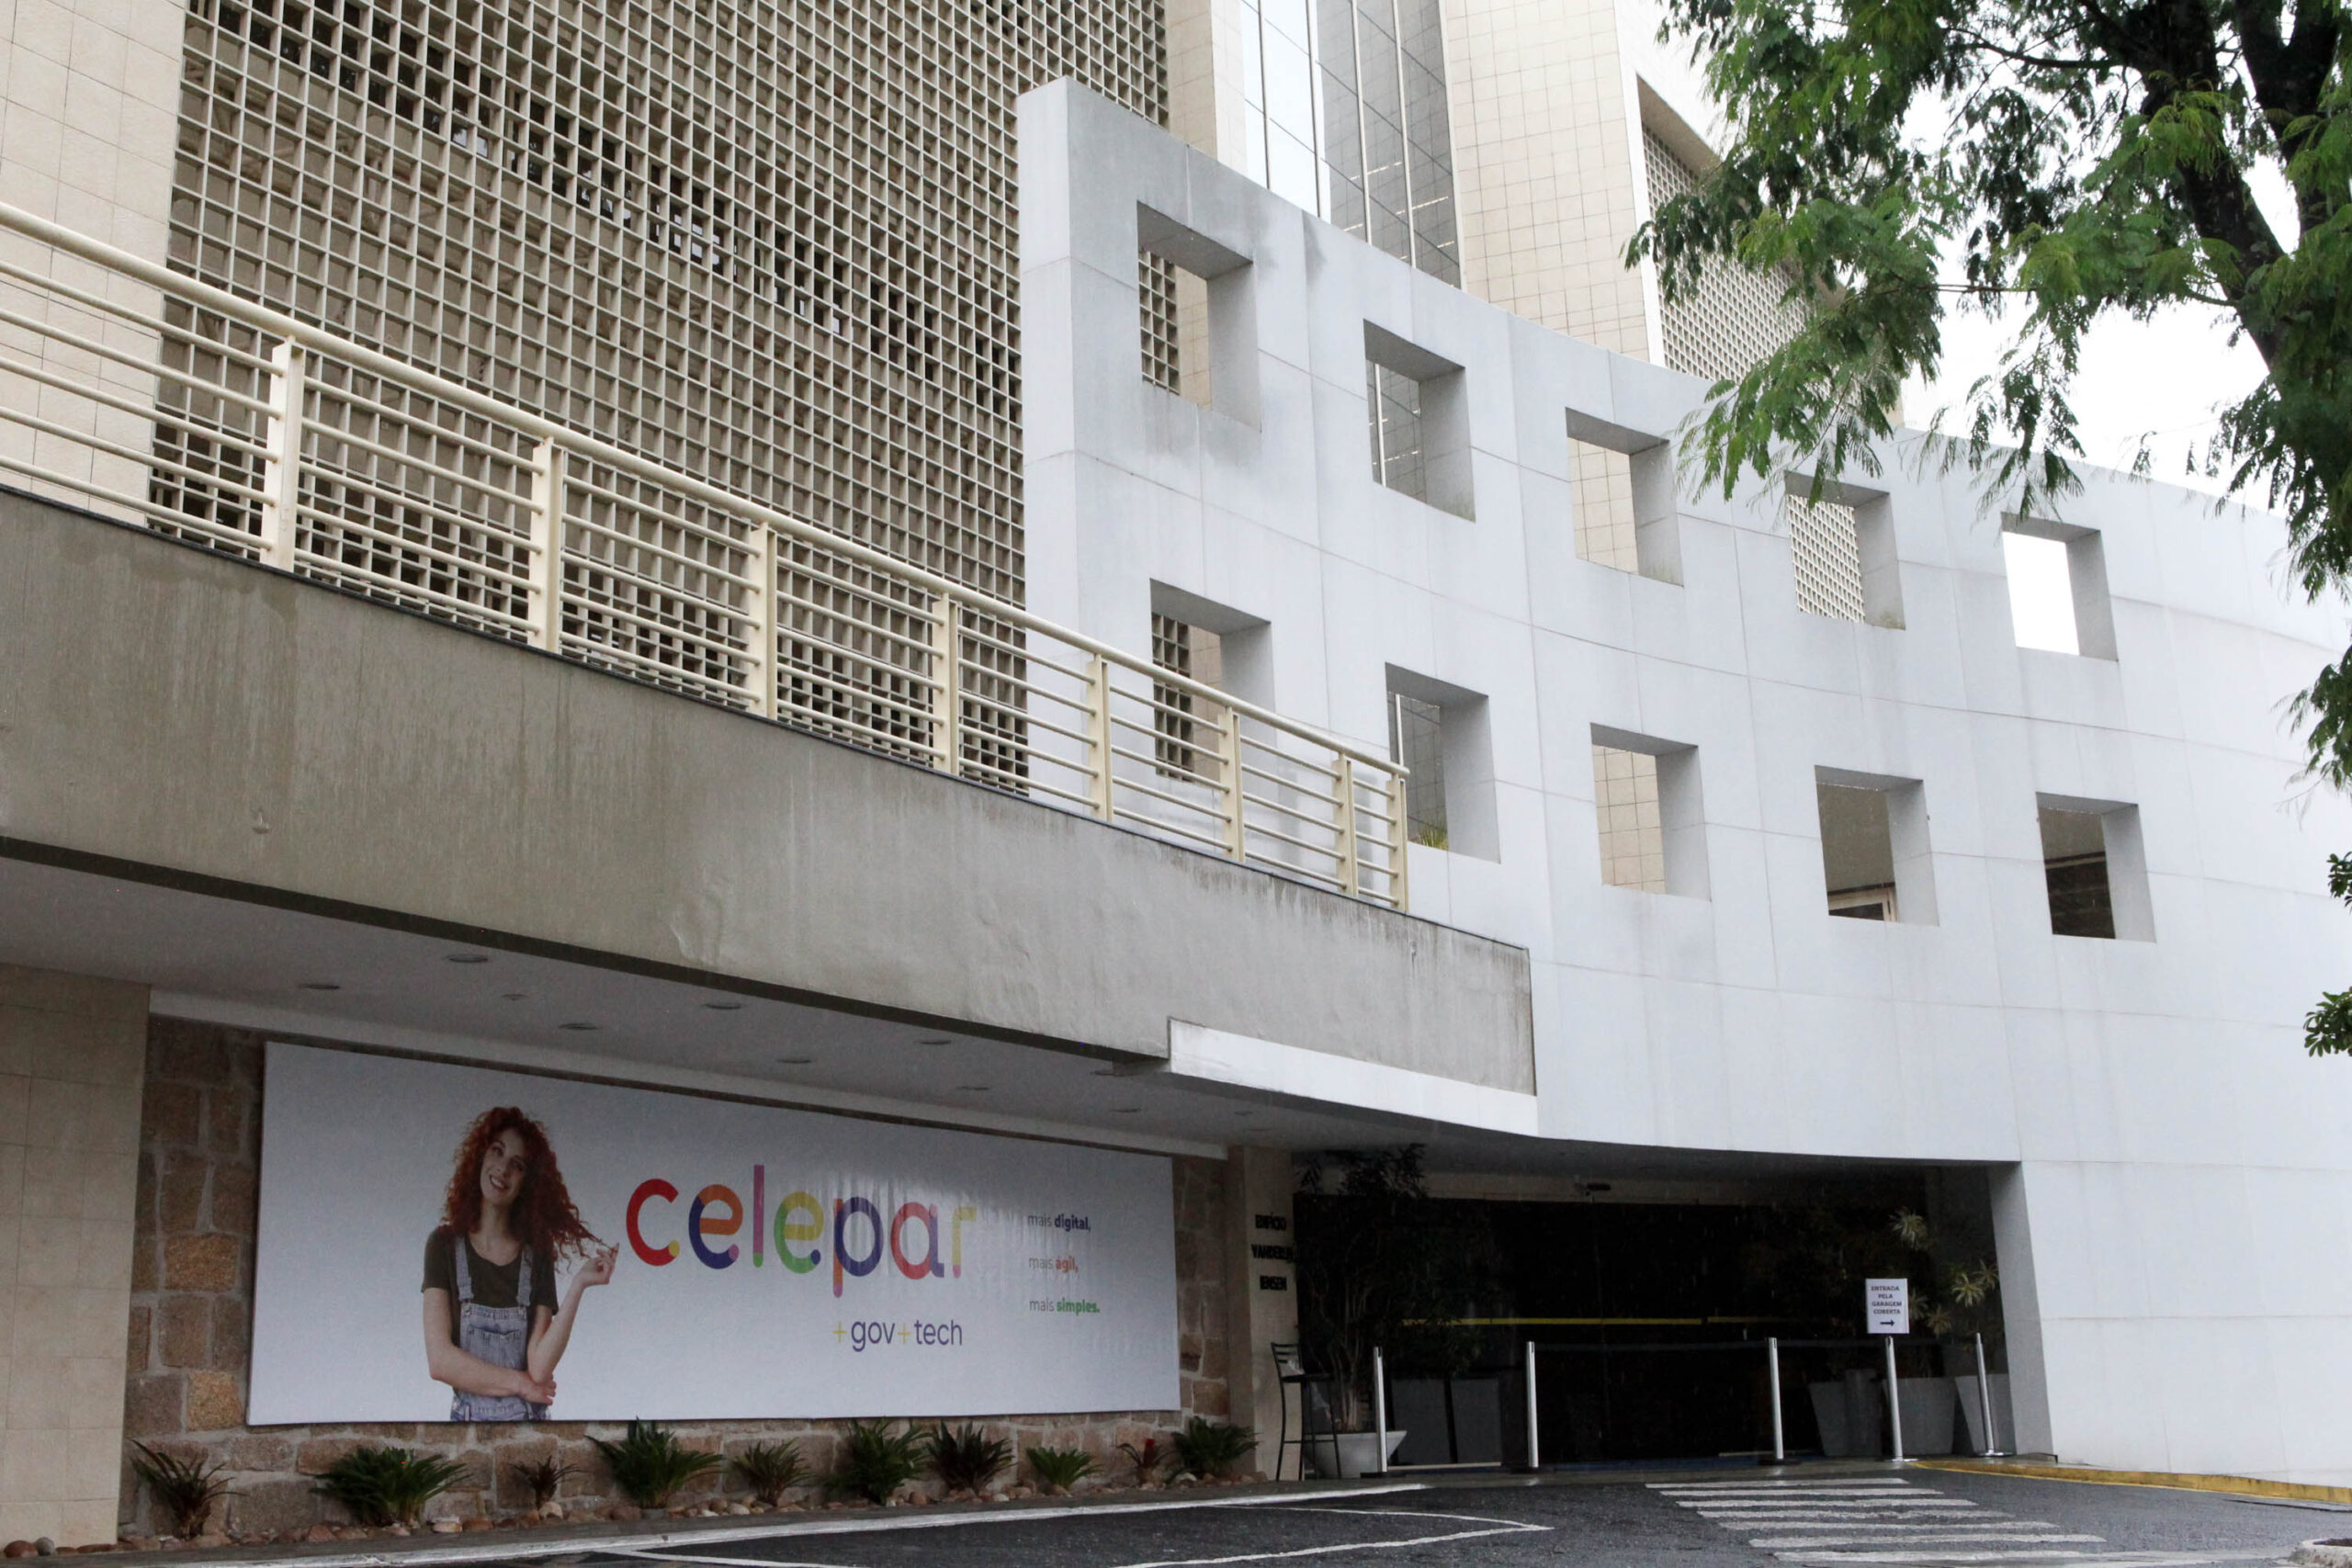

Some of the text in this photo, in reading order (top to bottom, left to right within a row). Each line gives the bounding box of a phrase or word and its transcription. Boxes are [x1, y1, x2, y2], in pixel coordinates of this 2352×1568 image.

[626, 1164, 978, 1298] celepar
[1028, 1213, 1091, 1233] mais digital,
[1029, 1255, 1079, 1274] mais ágil,
[1029, 1297, 1101, 1315] mais simples.
